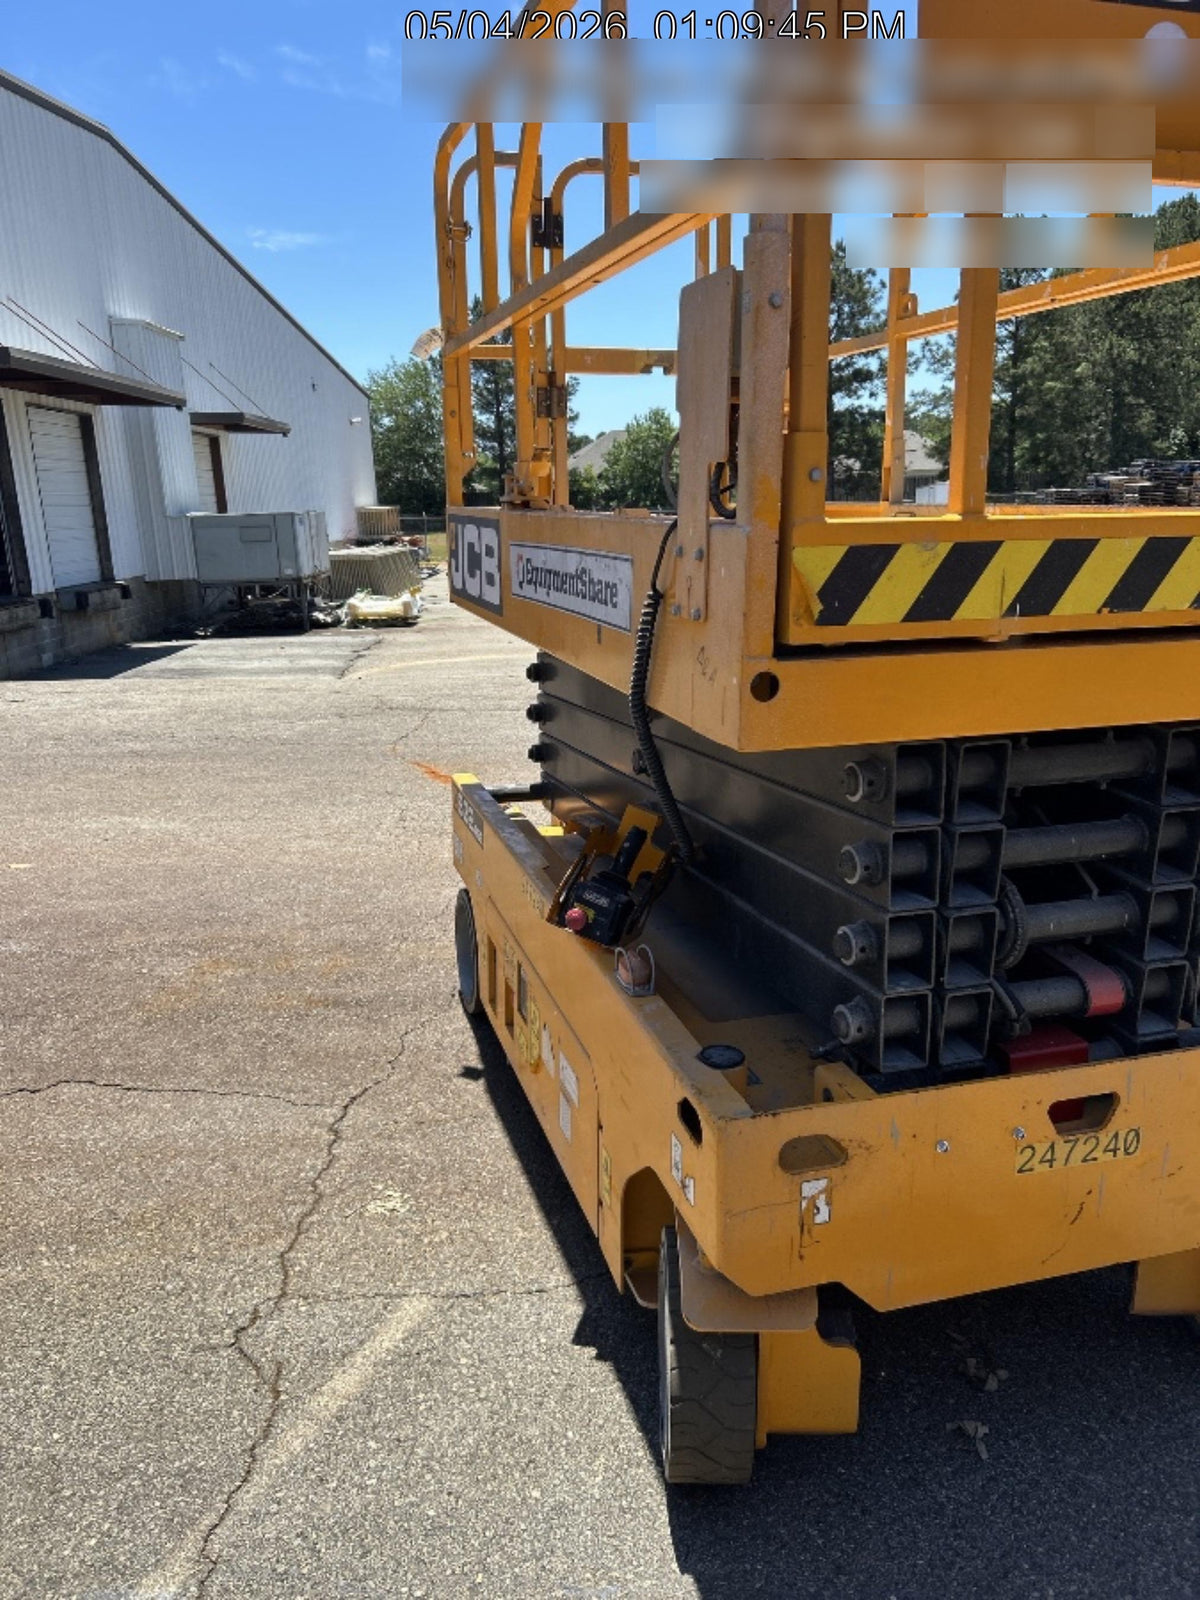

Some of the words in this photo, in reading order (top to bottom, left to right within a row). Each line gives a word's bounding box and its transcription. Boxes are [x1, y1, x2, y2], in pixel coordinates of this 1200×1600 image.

[450, 523, 500, 605] JCB
[525, 557, 618, 609] EquipmentShare
[1017, 1128, 1140, 1174] 247240
